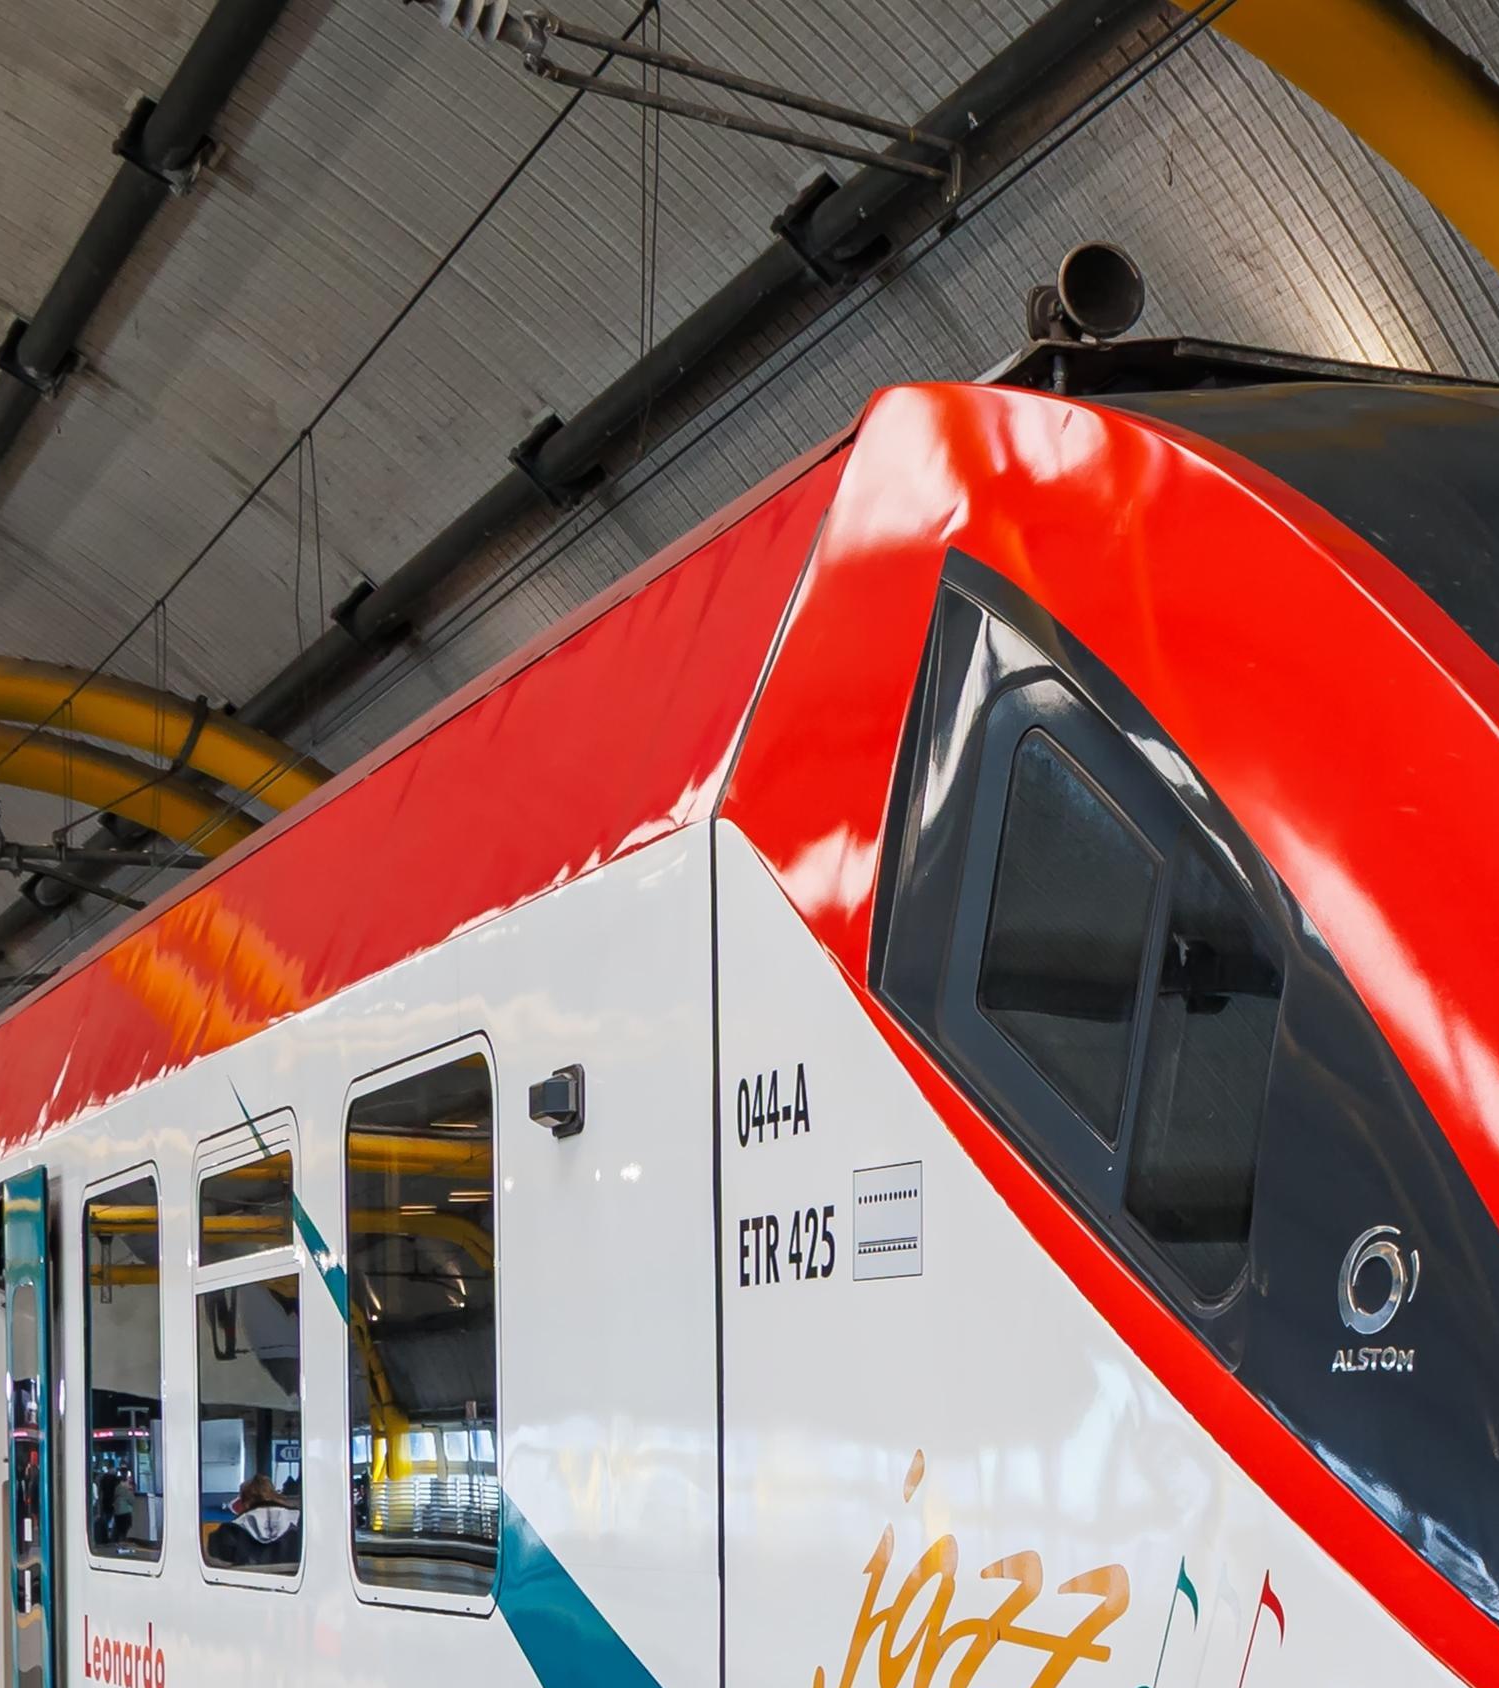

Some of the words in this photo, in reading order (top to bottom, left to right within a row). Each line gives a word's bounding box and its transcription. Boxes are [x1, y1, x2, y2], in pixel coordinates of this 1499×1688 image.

[737, 1063, 810, 1148] 044-A
[739, 1214, 780, 1288] ETR
[788, 1205, 836, 1281] 425
[1330, 1347, 1415, 1374] ALSTOM
